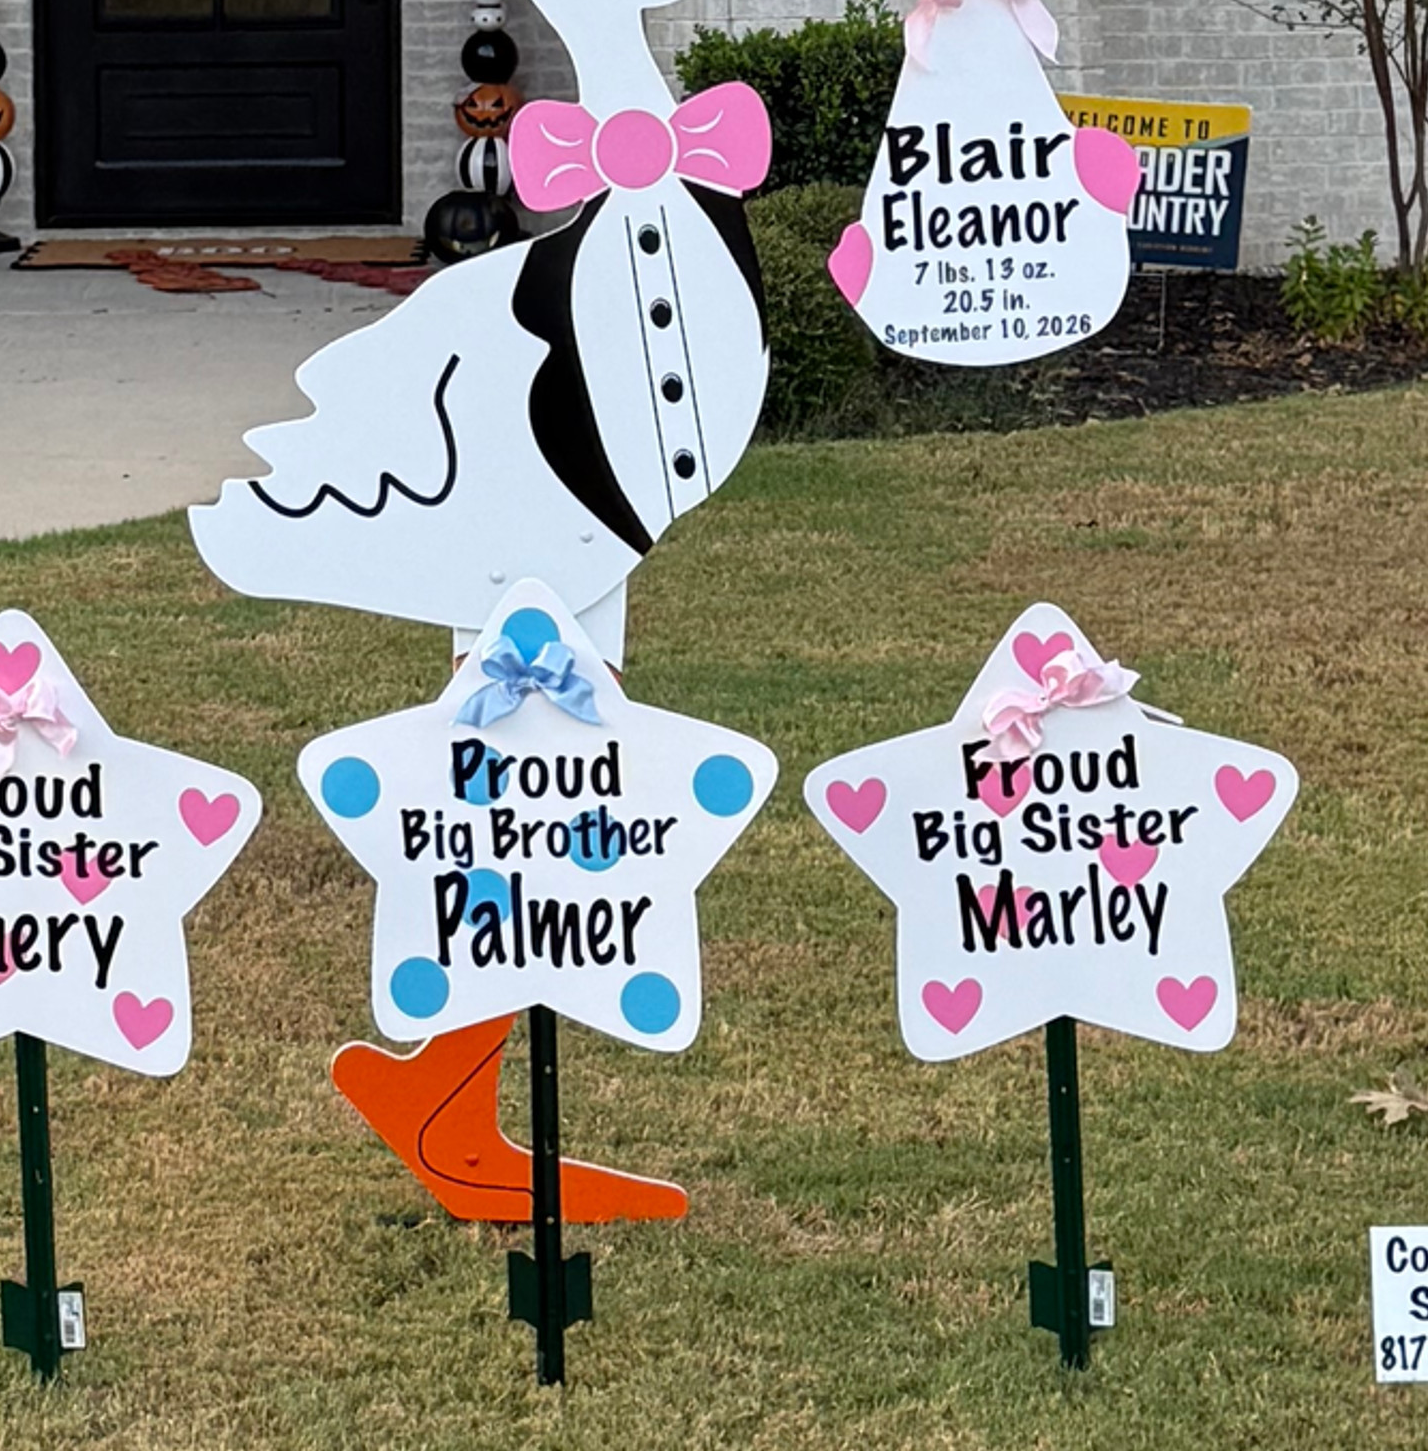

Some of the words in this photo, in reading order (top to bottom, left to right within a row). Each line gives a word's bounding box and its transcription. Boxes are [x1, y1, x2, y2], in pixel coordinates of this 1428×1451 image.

[884, 121, 1071, 187] Blair
[1184, 119, 1210, 140] TO
[1134, 146, 1232, 197] ADER
[882, 190, 1079, 251] Eleanor
[1127, 194, 1229, 237] UNTRY
[914, 260, 930, 286] 7
[937, 260, 976, 285] lbs.
[986, 257, 1015, 282] 13
[1021, 261, 1056, 280] oz.
[942, 288, 995, 314] 20.5
[1002, 288, 1031, 312] in.
[883, 322, 992, 348] September
[1000, 317, 1030, 341] 10,
[1036, 313, 1093, 338] 2026
[451, 738, 621, 800] Proud
[962, 734, 1139, 800] Proud
[401, 808, 474, 869] Big
[489, 804, 678, 860] Brother
[912, 810, 1002, 866] Big
[1021, 802, 1198, 853] Sister
[434, 871, 652, 969] Palmer
[956, 863, 1168, 956] Marley
